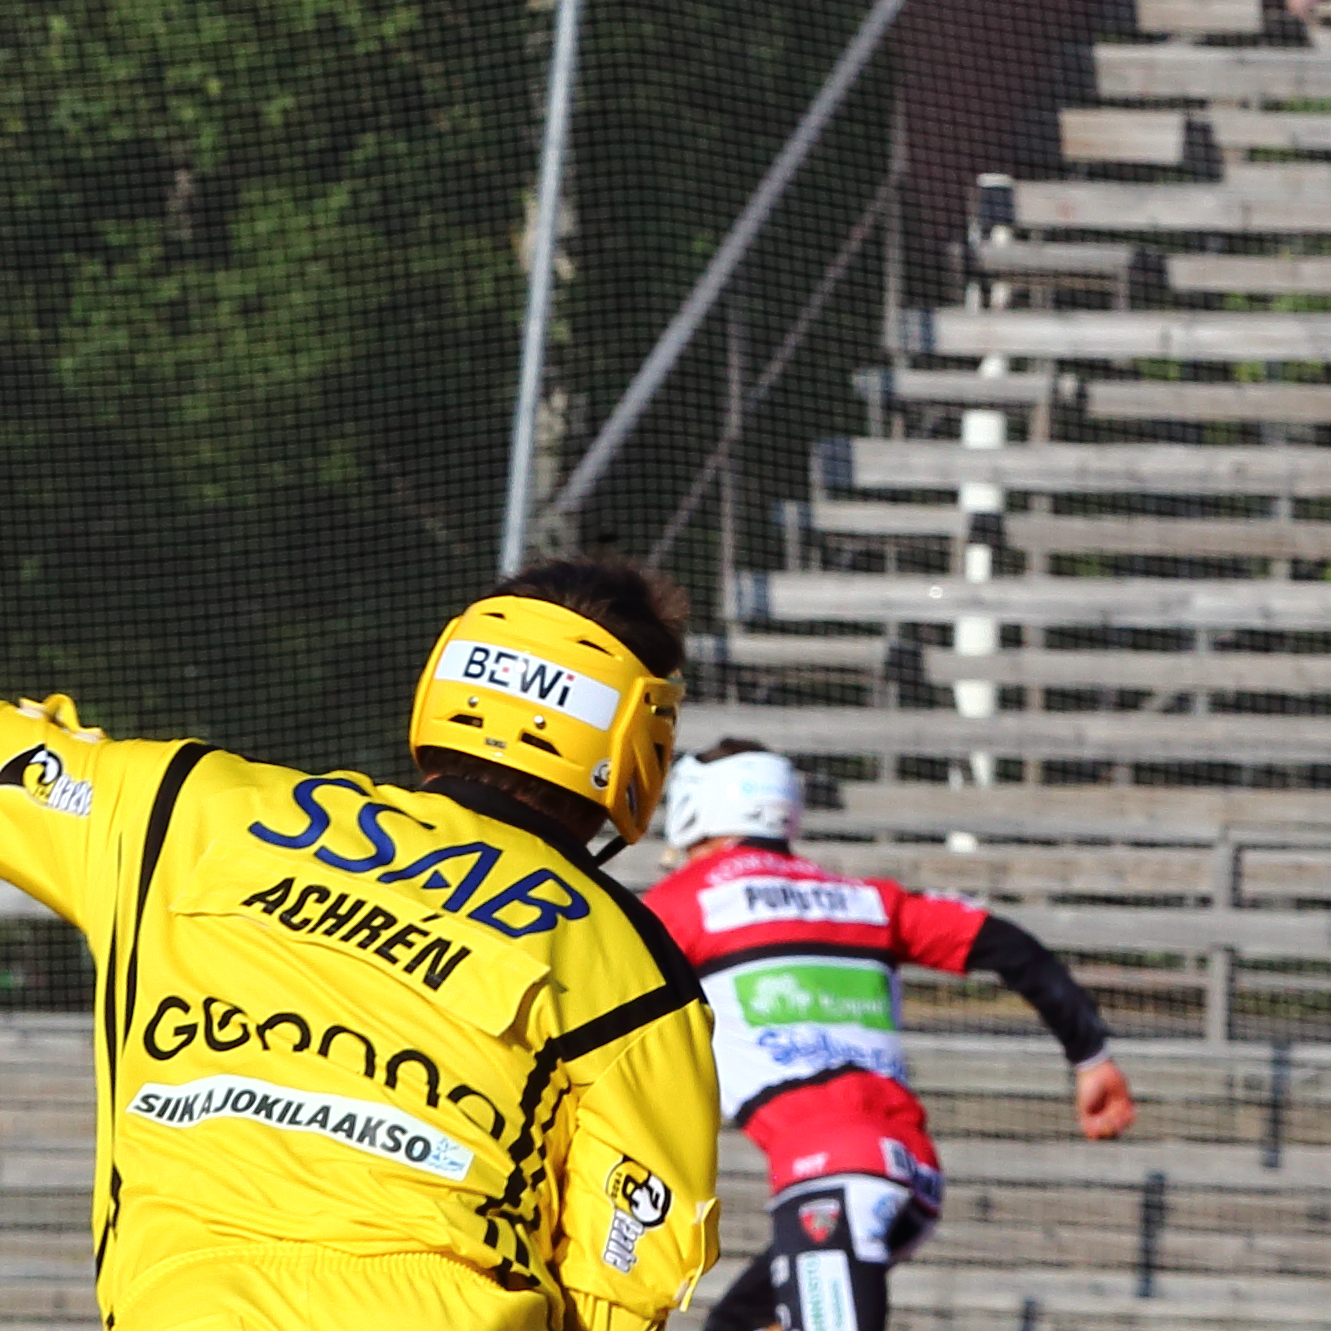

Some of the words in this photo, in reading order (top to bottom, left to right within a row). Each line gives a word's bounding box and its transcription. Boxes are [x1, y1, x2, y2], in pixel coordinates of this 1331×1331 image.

[463, 646, 575, 708] BEWi
[248, 777, 590, 939] SSAB
[241, 876, 472, 992] ACHRÉN
[133, 1086, 432, 1163] SIIKAJOKILAAKSO
